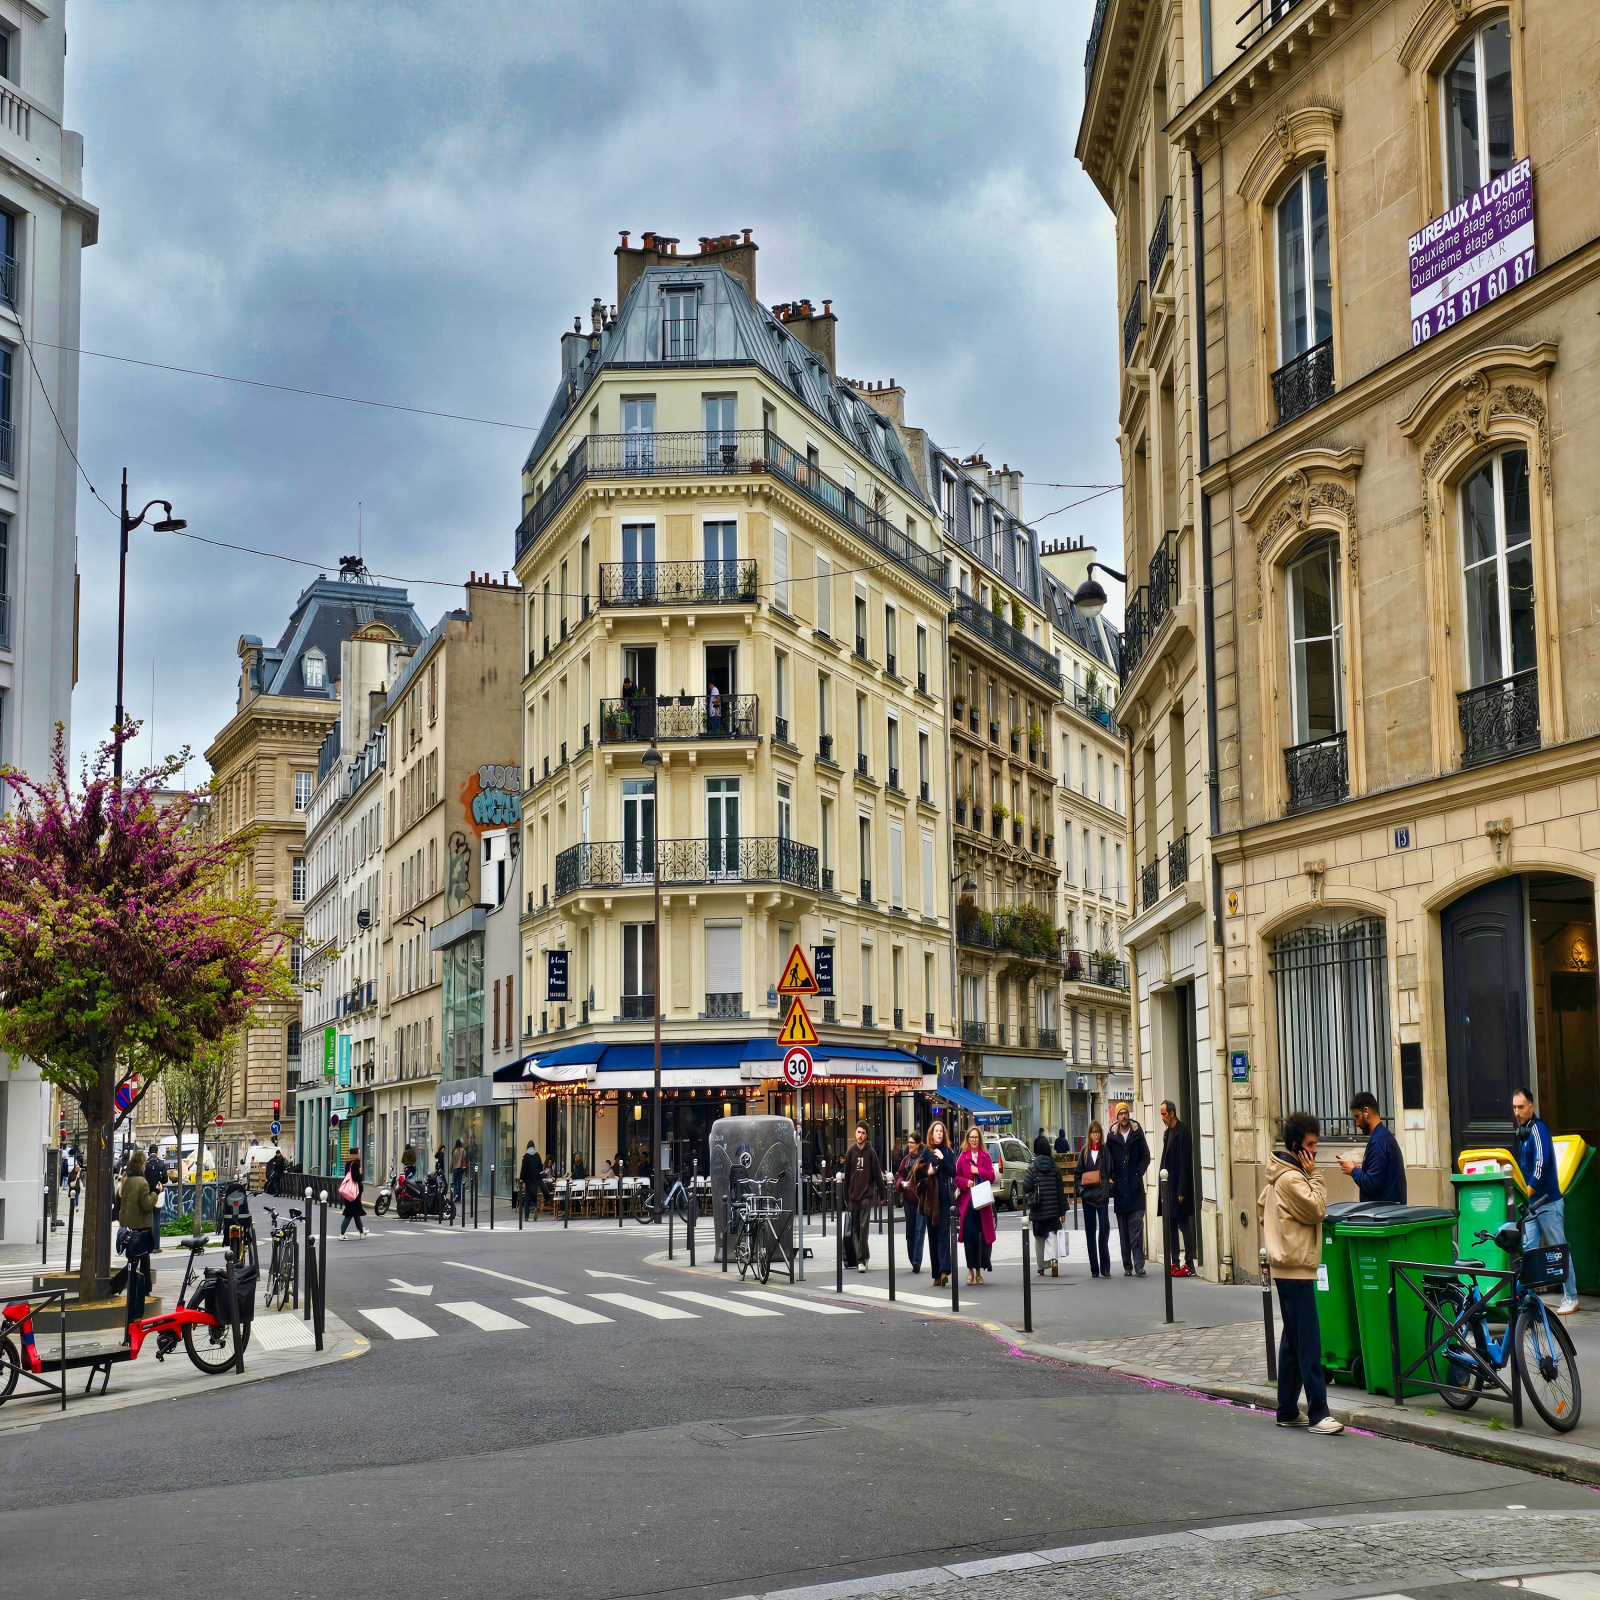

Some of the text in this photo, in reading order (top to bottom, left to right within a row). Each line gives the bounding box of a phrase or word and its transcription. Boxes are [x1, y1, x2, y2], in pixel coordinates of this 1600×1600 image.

[1409, 158, 1531, 257] BUREAUX A LOUER
[1411, 253, 1462, 289] Quatrième
[1465, 228, 1494, 253] étage
[1497, 199, 1531, 233] 138m²
[1412, 232, 1460, 273] Deuxième
[1463, 210, 1492, 238] étage
[1495, 182, 1529, 217] 250m²
[1412, 316, 1431, 346] 06
[1436, 298, 1456, 332] 25
[1462, 283, 1481, 314] 87
[1488, 266, 1508, 301] 60
[1514, 250, 1534, 283] 87
[1458, 240, 1507, 281] SAFAR
[1397, 829, 1407, 848] 13
[789, 1059, 807, 1075] 30
